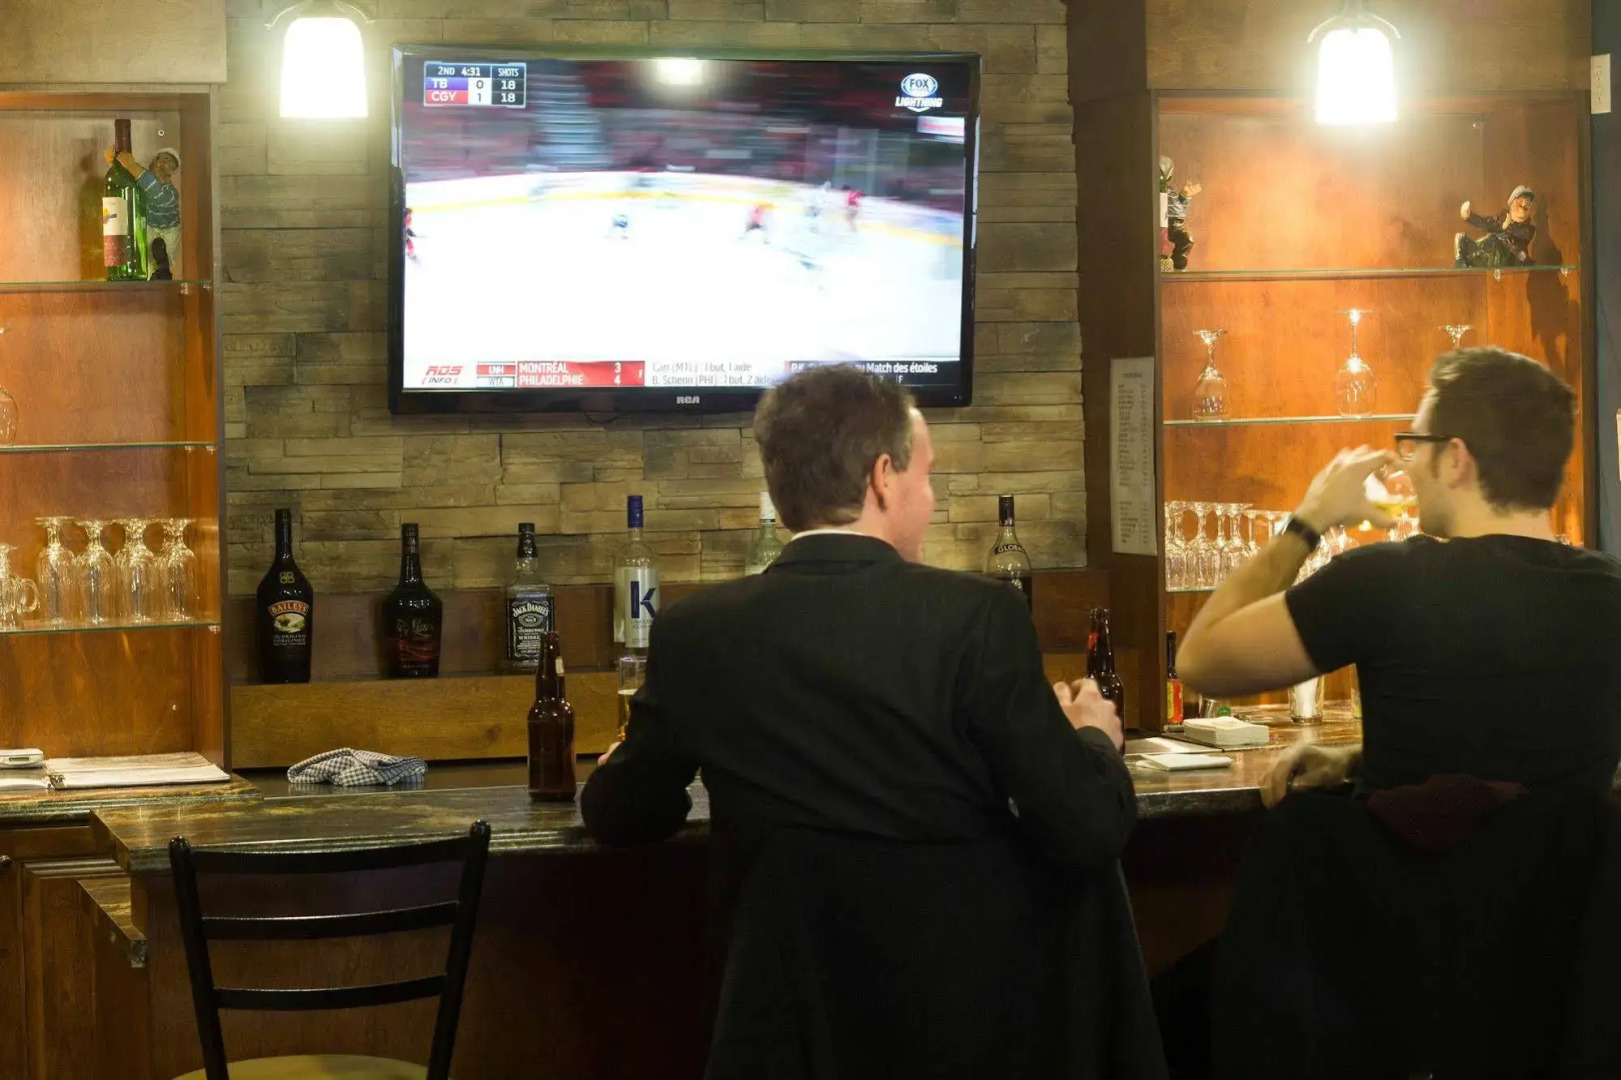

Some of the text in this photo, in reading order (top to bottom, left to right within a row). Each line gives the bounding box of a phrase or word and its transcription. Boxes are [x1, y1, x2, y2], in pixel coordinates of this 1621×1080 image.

[437, 66, 481, 76] 2ND 4:31
[498, 68, 519, 77] SHOTS
[431, 78, 484, 89] TB 0
[500, 80, 516, 90] 18
[909, 78, 929, 88] FOX
[430, 91, 482, 102] CGY 1
[500, 92, 516, 102] 18
[895, 96, 943, 107] LIGHTNING
[518, 362, 622, 374] MONTRÉAL 3
[866, 362, 892, 374] Match
[893, 362, 909, 374] des
[910, 362, 938, 374] étoiles
[488, 378, 504, 386] WTA
[519, 375, 622, 386] PHILADELPHIE 4
[662, 375, 694, 386] Schenn
[676, 396, 700, 404] RCA
[271, 602, 307, 614] BAILEYS
[512, 605, 528, 618] JACK
